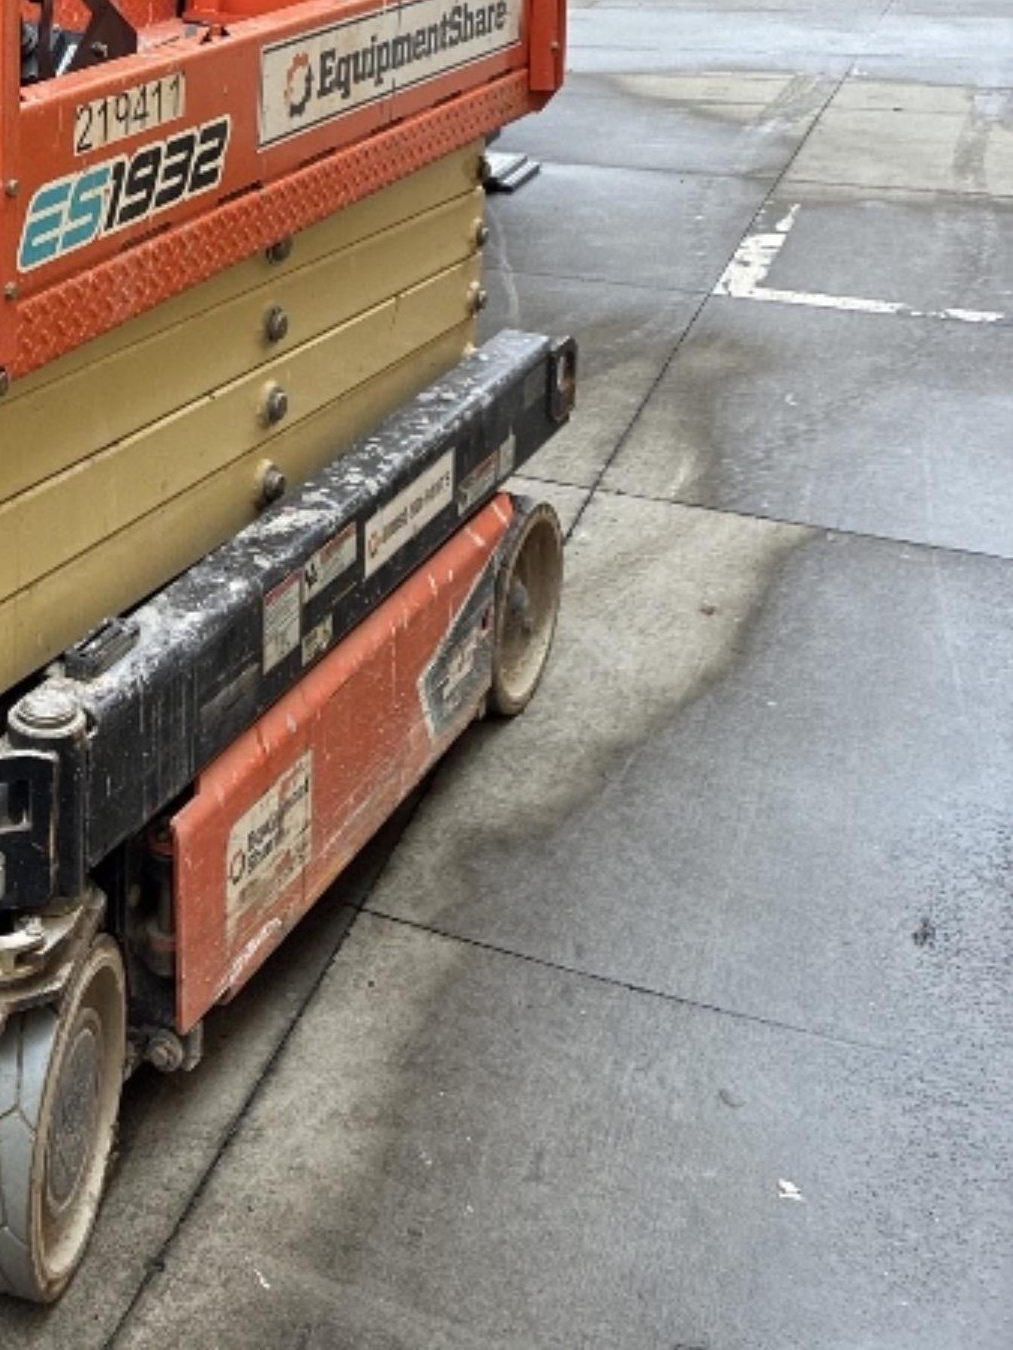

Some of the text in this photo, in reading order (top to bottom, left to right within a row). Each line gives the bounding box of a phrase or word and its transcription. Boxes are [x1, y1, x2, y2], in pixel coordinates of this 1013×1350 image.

[316, 0, 507, 99] EquipmentShare
[76, 74, 182, 154] 219411
[17, 114, 231, 272] ES1932
